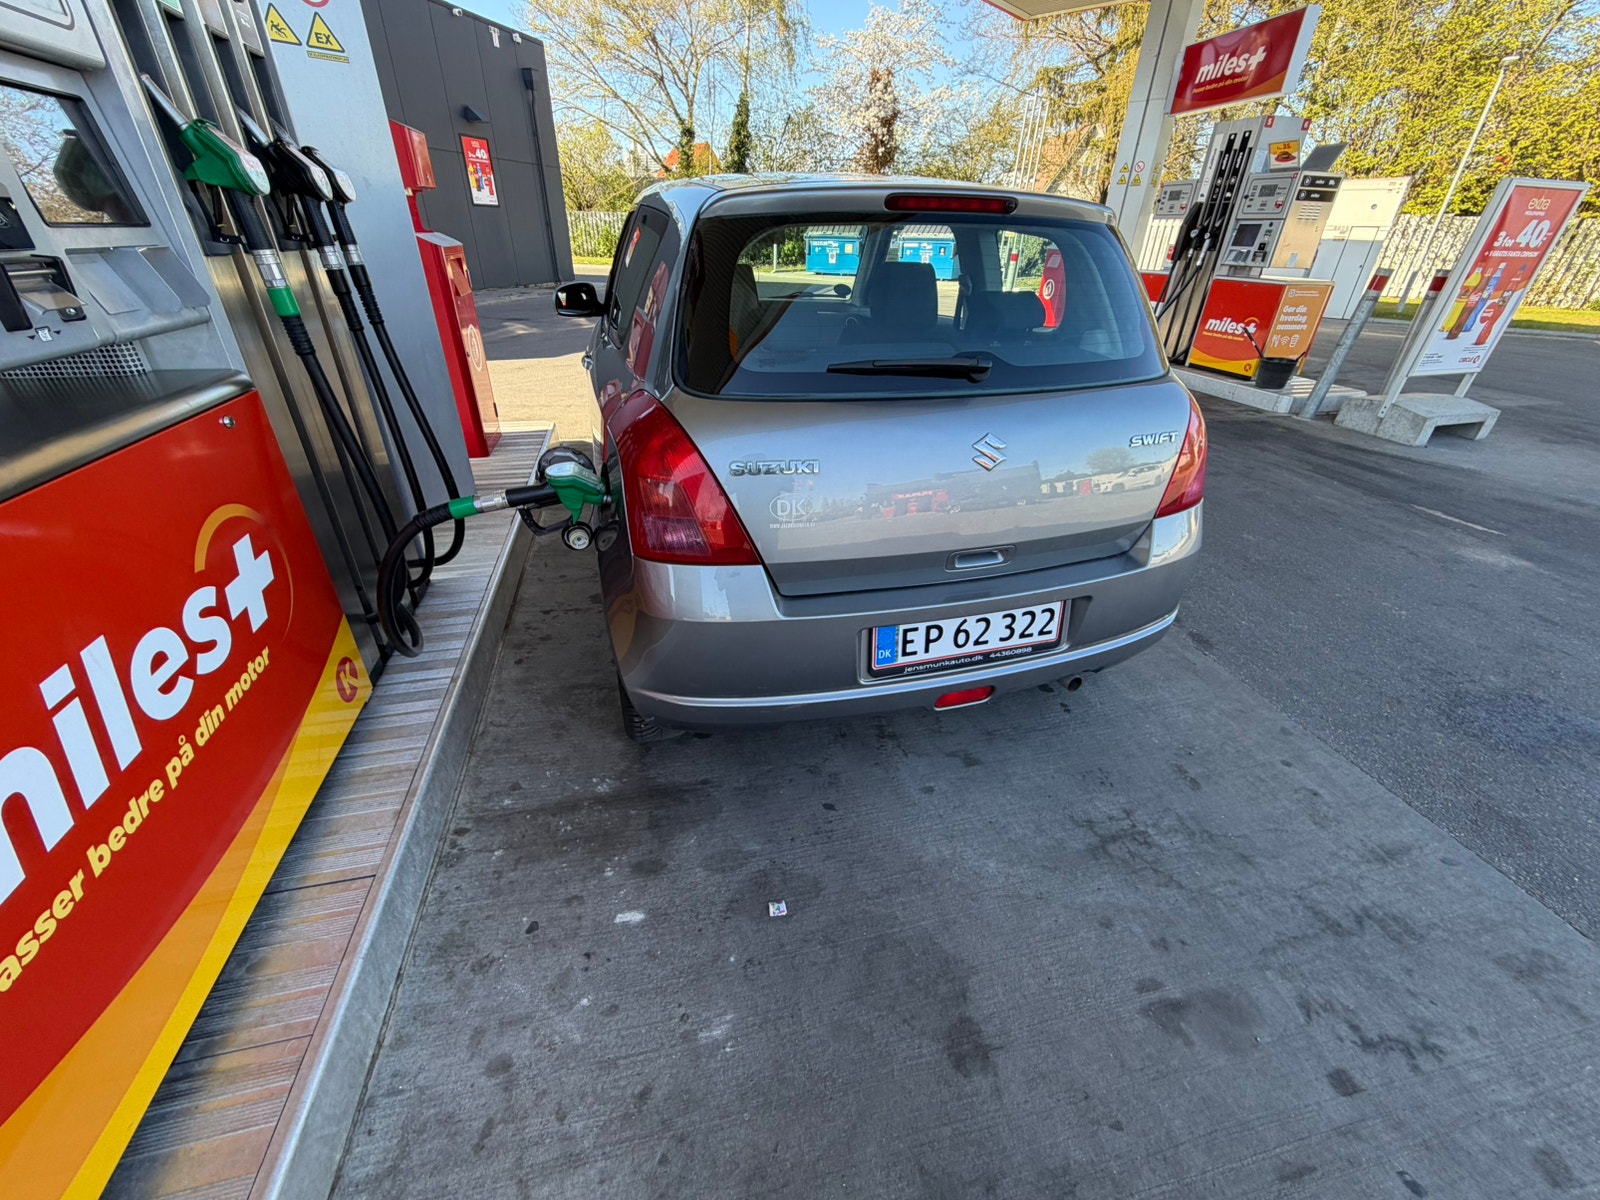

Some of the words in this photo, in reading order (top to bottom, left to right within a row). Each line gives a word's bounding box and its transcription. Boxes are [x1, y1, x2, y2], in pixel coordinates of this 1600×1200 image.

[314, 32, 334, 46] EX
[1194, 46, 1267, 84] miles+
[1493, 231, 1507, 247] 3
[1502, 237, 1515, 247] for
[1129, 431, 1179, 448] SWIFT
[729, 460, 820, 476] SUZUKI
[776, 499, 808, 517] DK
[901, 624, 944, 658] EP
[953, 616, 991, 649] 62
[998, 607, 1056, 643] 322
[878, 649, 892, 659] DK
[903, 654, 984, 674] jensmunkauto.dk
[989, 647, 1033, 659] 44360898
[86, 778, 165, 878] bedre
[165, 735, 195, 789] på
[195, 704, 225, 746] din
[224, 646, 270, 711] motor
